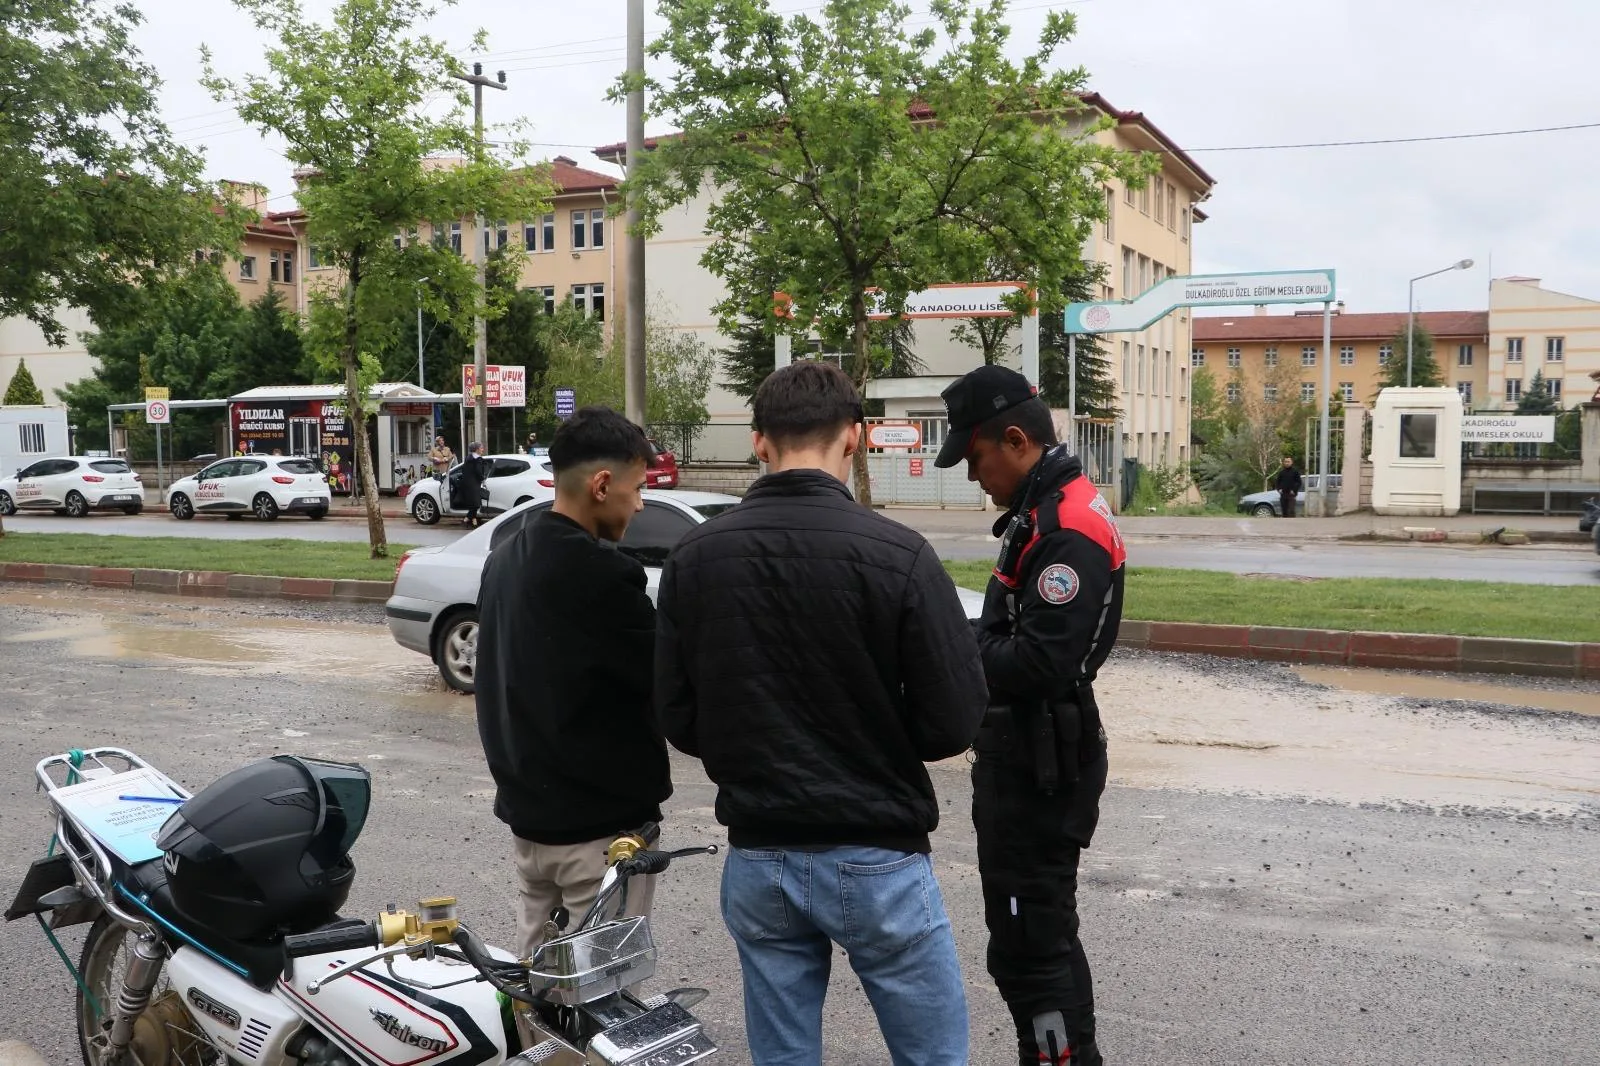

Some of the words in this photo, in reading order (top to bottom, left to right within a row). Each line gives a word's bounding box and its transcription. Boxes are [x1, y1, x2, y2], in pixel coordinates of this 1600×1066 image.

[1235, 286, 1251, 297] ÖZEL
[1277, 285, 1304, 296] MESLEK
[1305, 285, 1328, 295] OKULU
[920, 304, 976, 312] ANADOLU
[502, 371, 523, 382] UFUK
[153, 407, 163, 416] 30
[239, 409, 284, 420] YILDIZLAR
[239, 421, 263, 430] SÜRÜCÜ
[1476, 431, 1510, 439] MESLEK
[1512, 431, 1543, 439] OKULU
